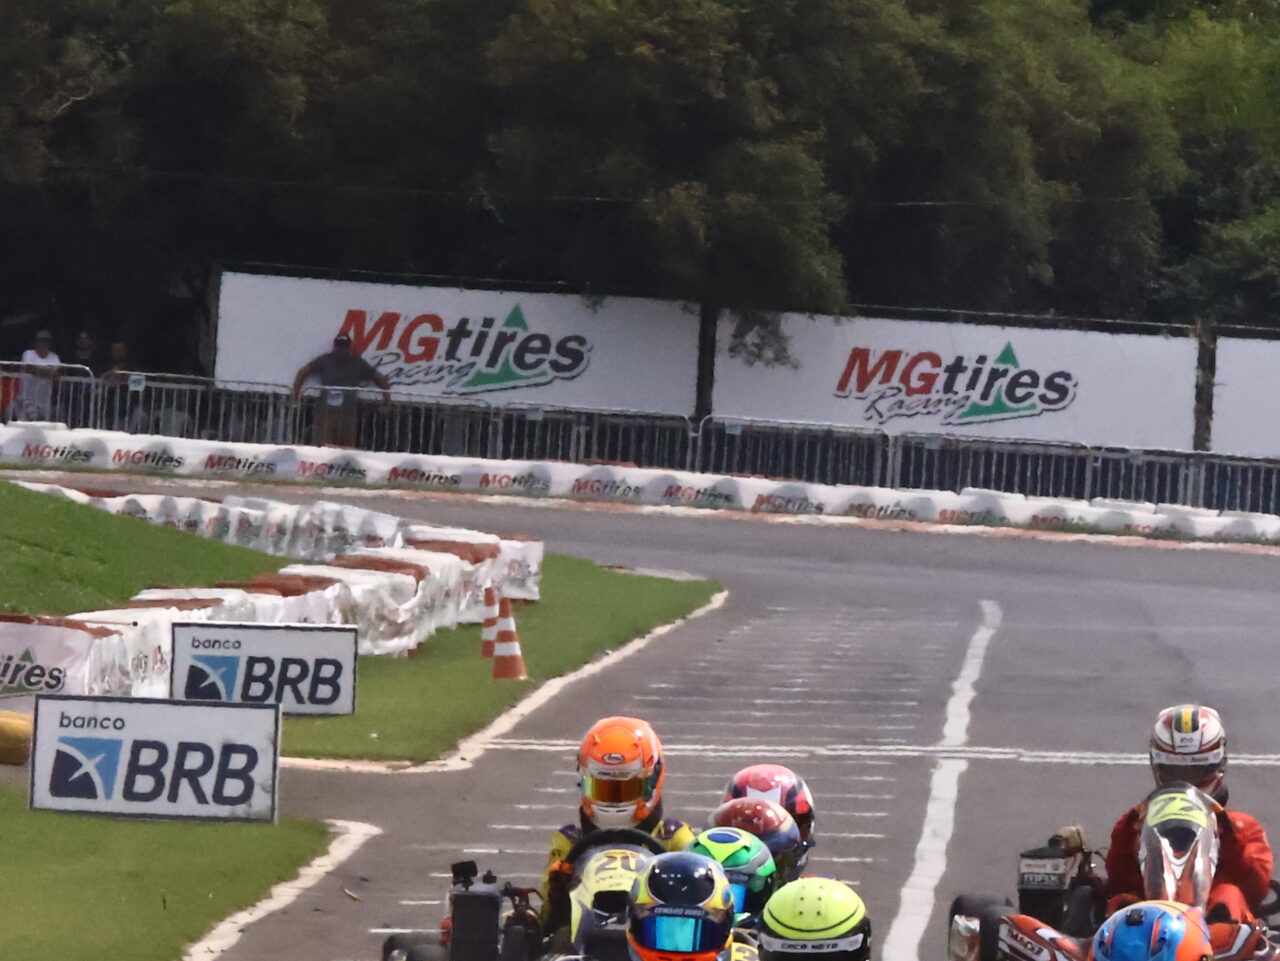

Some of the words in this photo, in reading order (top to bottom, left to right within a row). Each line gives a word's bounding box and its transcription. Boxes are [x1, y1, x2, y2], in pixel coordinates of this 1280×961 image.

[335, 309, 588, 374] MGtires
[836, 346, 1074, 405] MGtires
[865, 386, 972, 420] Racing
[111, 448, 183, 469] MGtires
[204, 453, 276, 475] MGtires
[191, 636, 242, 650] banco
[0, 654, 65, 690] ires
[240, 655, 344, 706] BRB
[58, 711, 126, 731] banco
[122, 739, 259, 806] BRB
